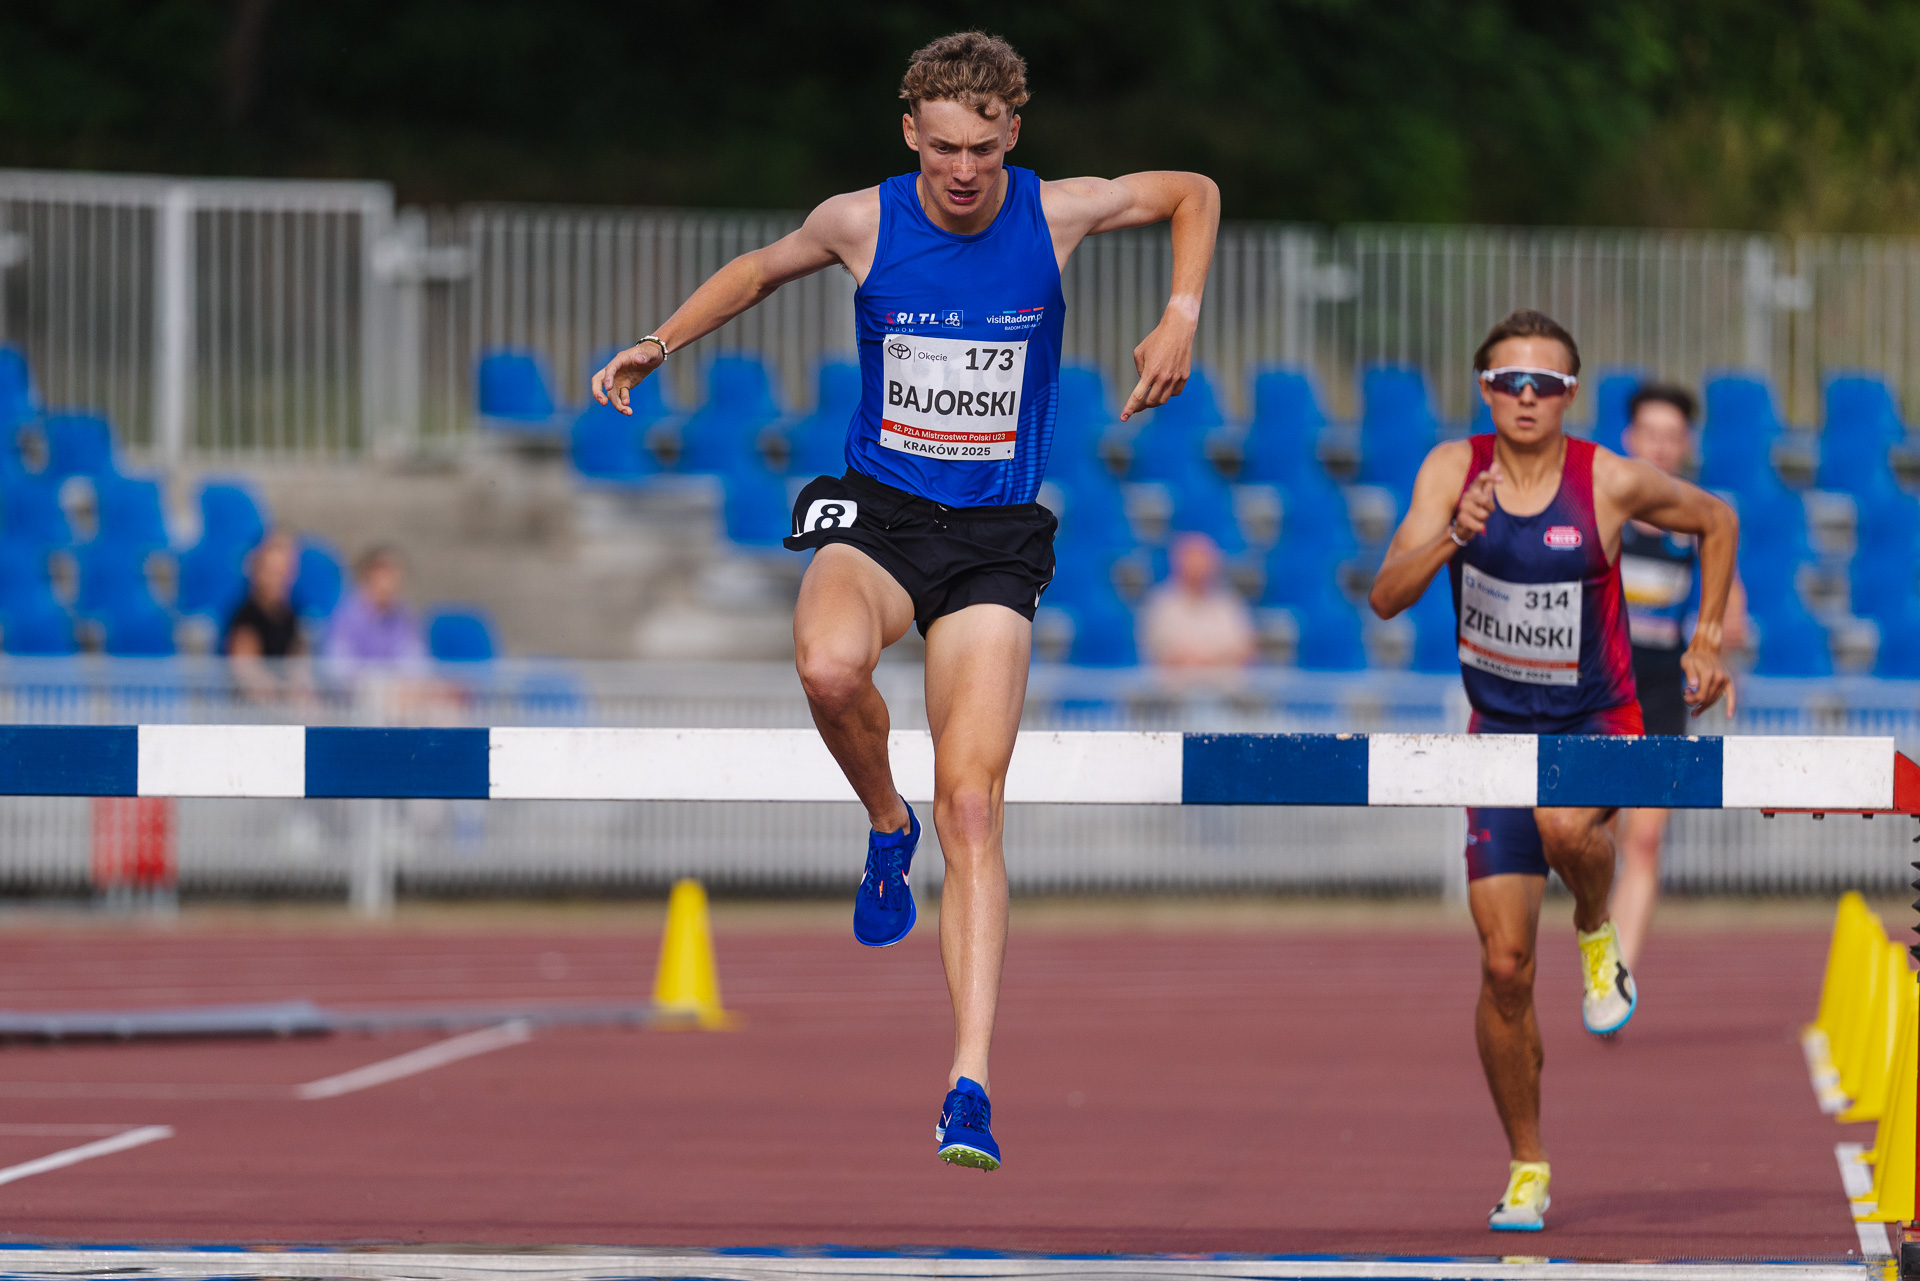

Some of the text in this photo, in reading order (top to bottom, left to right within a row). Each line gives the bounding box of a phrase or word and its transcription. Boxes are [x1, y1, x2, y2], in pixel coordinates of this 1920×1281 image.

[918, 351, 948, 362] Okęcie
[965, 348, 1015, 371] 173
[888, 380, 1016, 417] BAJORSKI
[893, 423, 1006, 442] 42. PZLA Mistrzostwa Polski U23
[903, 439, 991, 456] KRAKÓW 2025
[814, 503, 846, 530] 8
[1525, 590, 1569, 610] 314
[1464, 604, 1573, 649] ZIELIŃSKI
